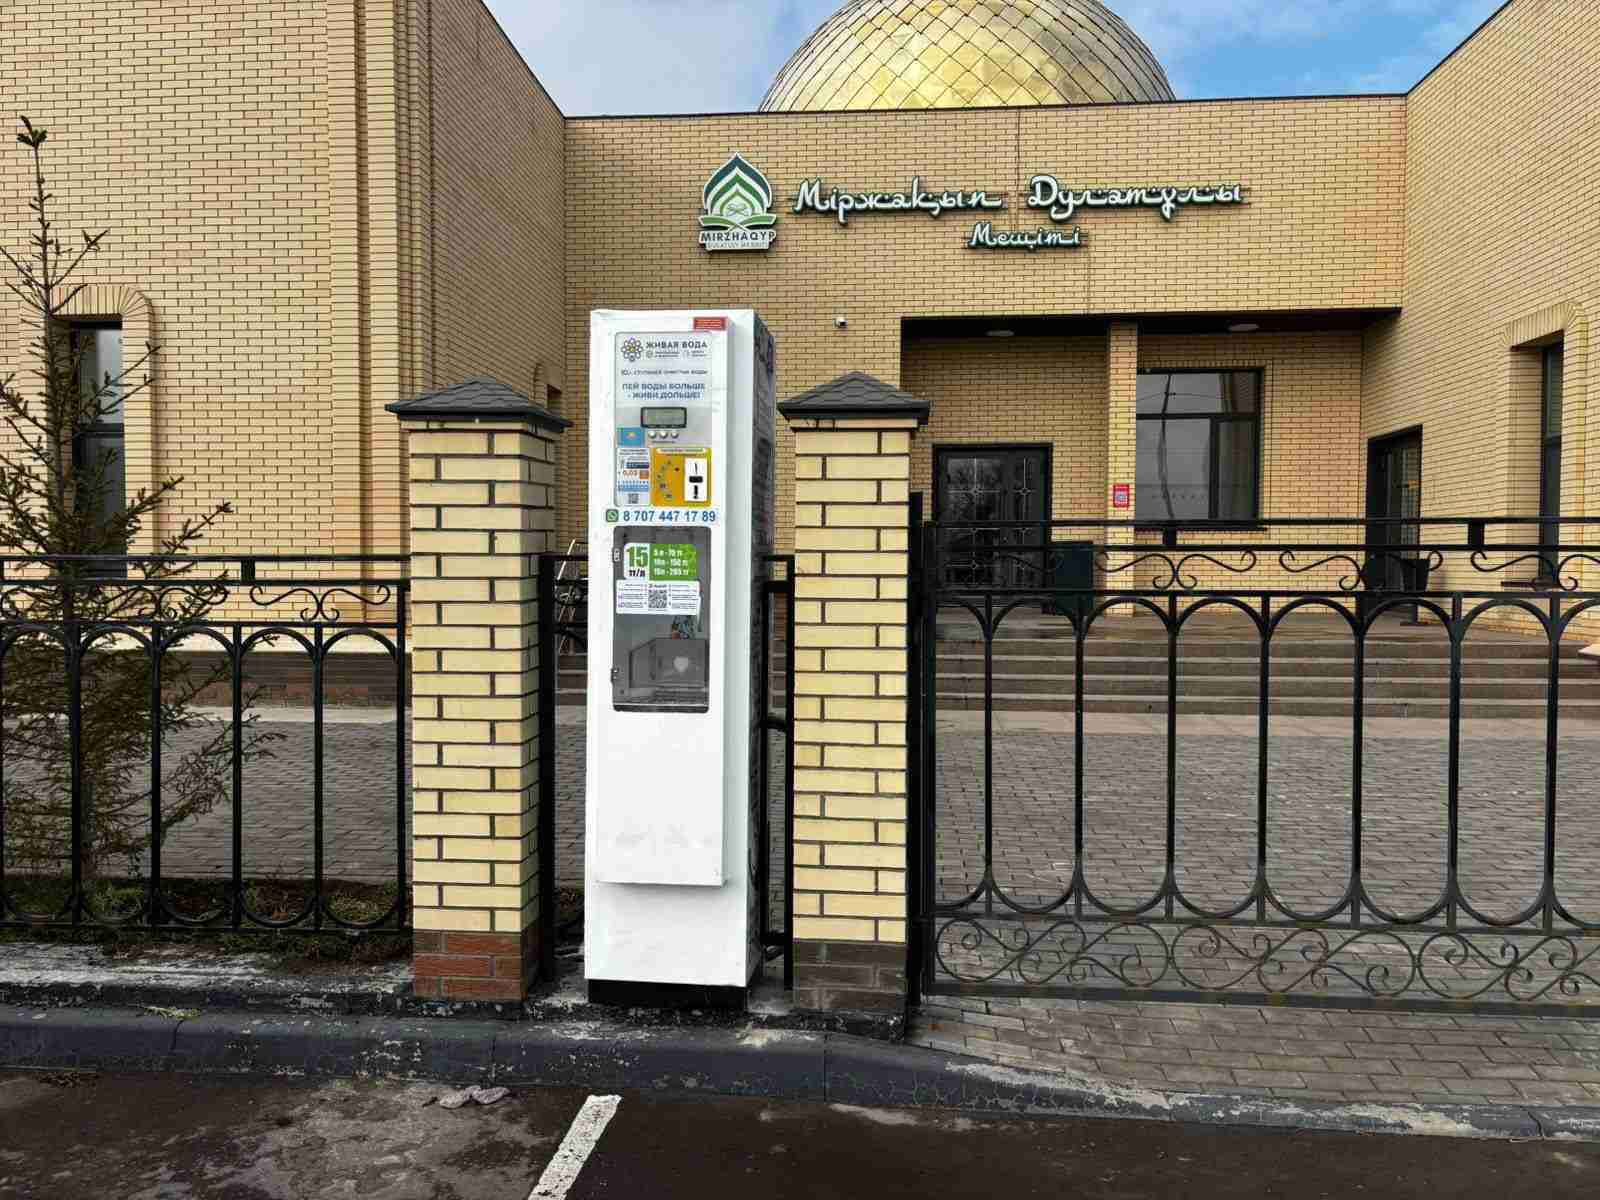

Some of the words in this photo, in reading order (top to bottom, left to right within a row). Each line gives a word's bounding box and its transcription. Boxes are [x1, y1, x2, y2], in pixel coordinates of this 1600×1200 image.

[794, 176, 1002, 224] Міржақып
[701, 231, 776, 242] MIRZHAQYP
[646, 341, 679, 349] ЖИВАЯ
[682, 341, 708, 349] ВОДА
[622, 382, 639, 390] ПЕЙ
[641, 383, 667, 391] ВОДЫ
[660, 391, 701, 399] ДОЛЬШЕ!
[623, 510, 631, 522] 8
[634, 510, 655, 522] 707
[658, 510, 680, 522] 447
[684, 510, 698, 522] 17
[702, 510, 716, 522] 89
[627, 546, 648, 567] 15
